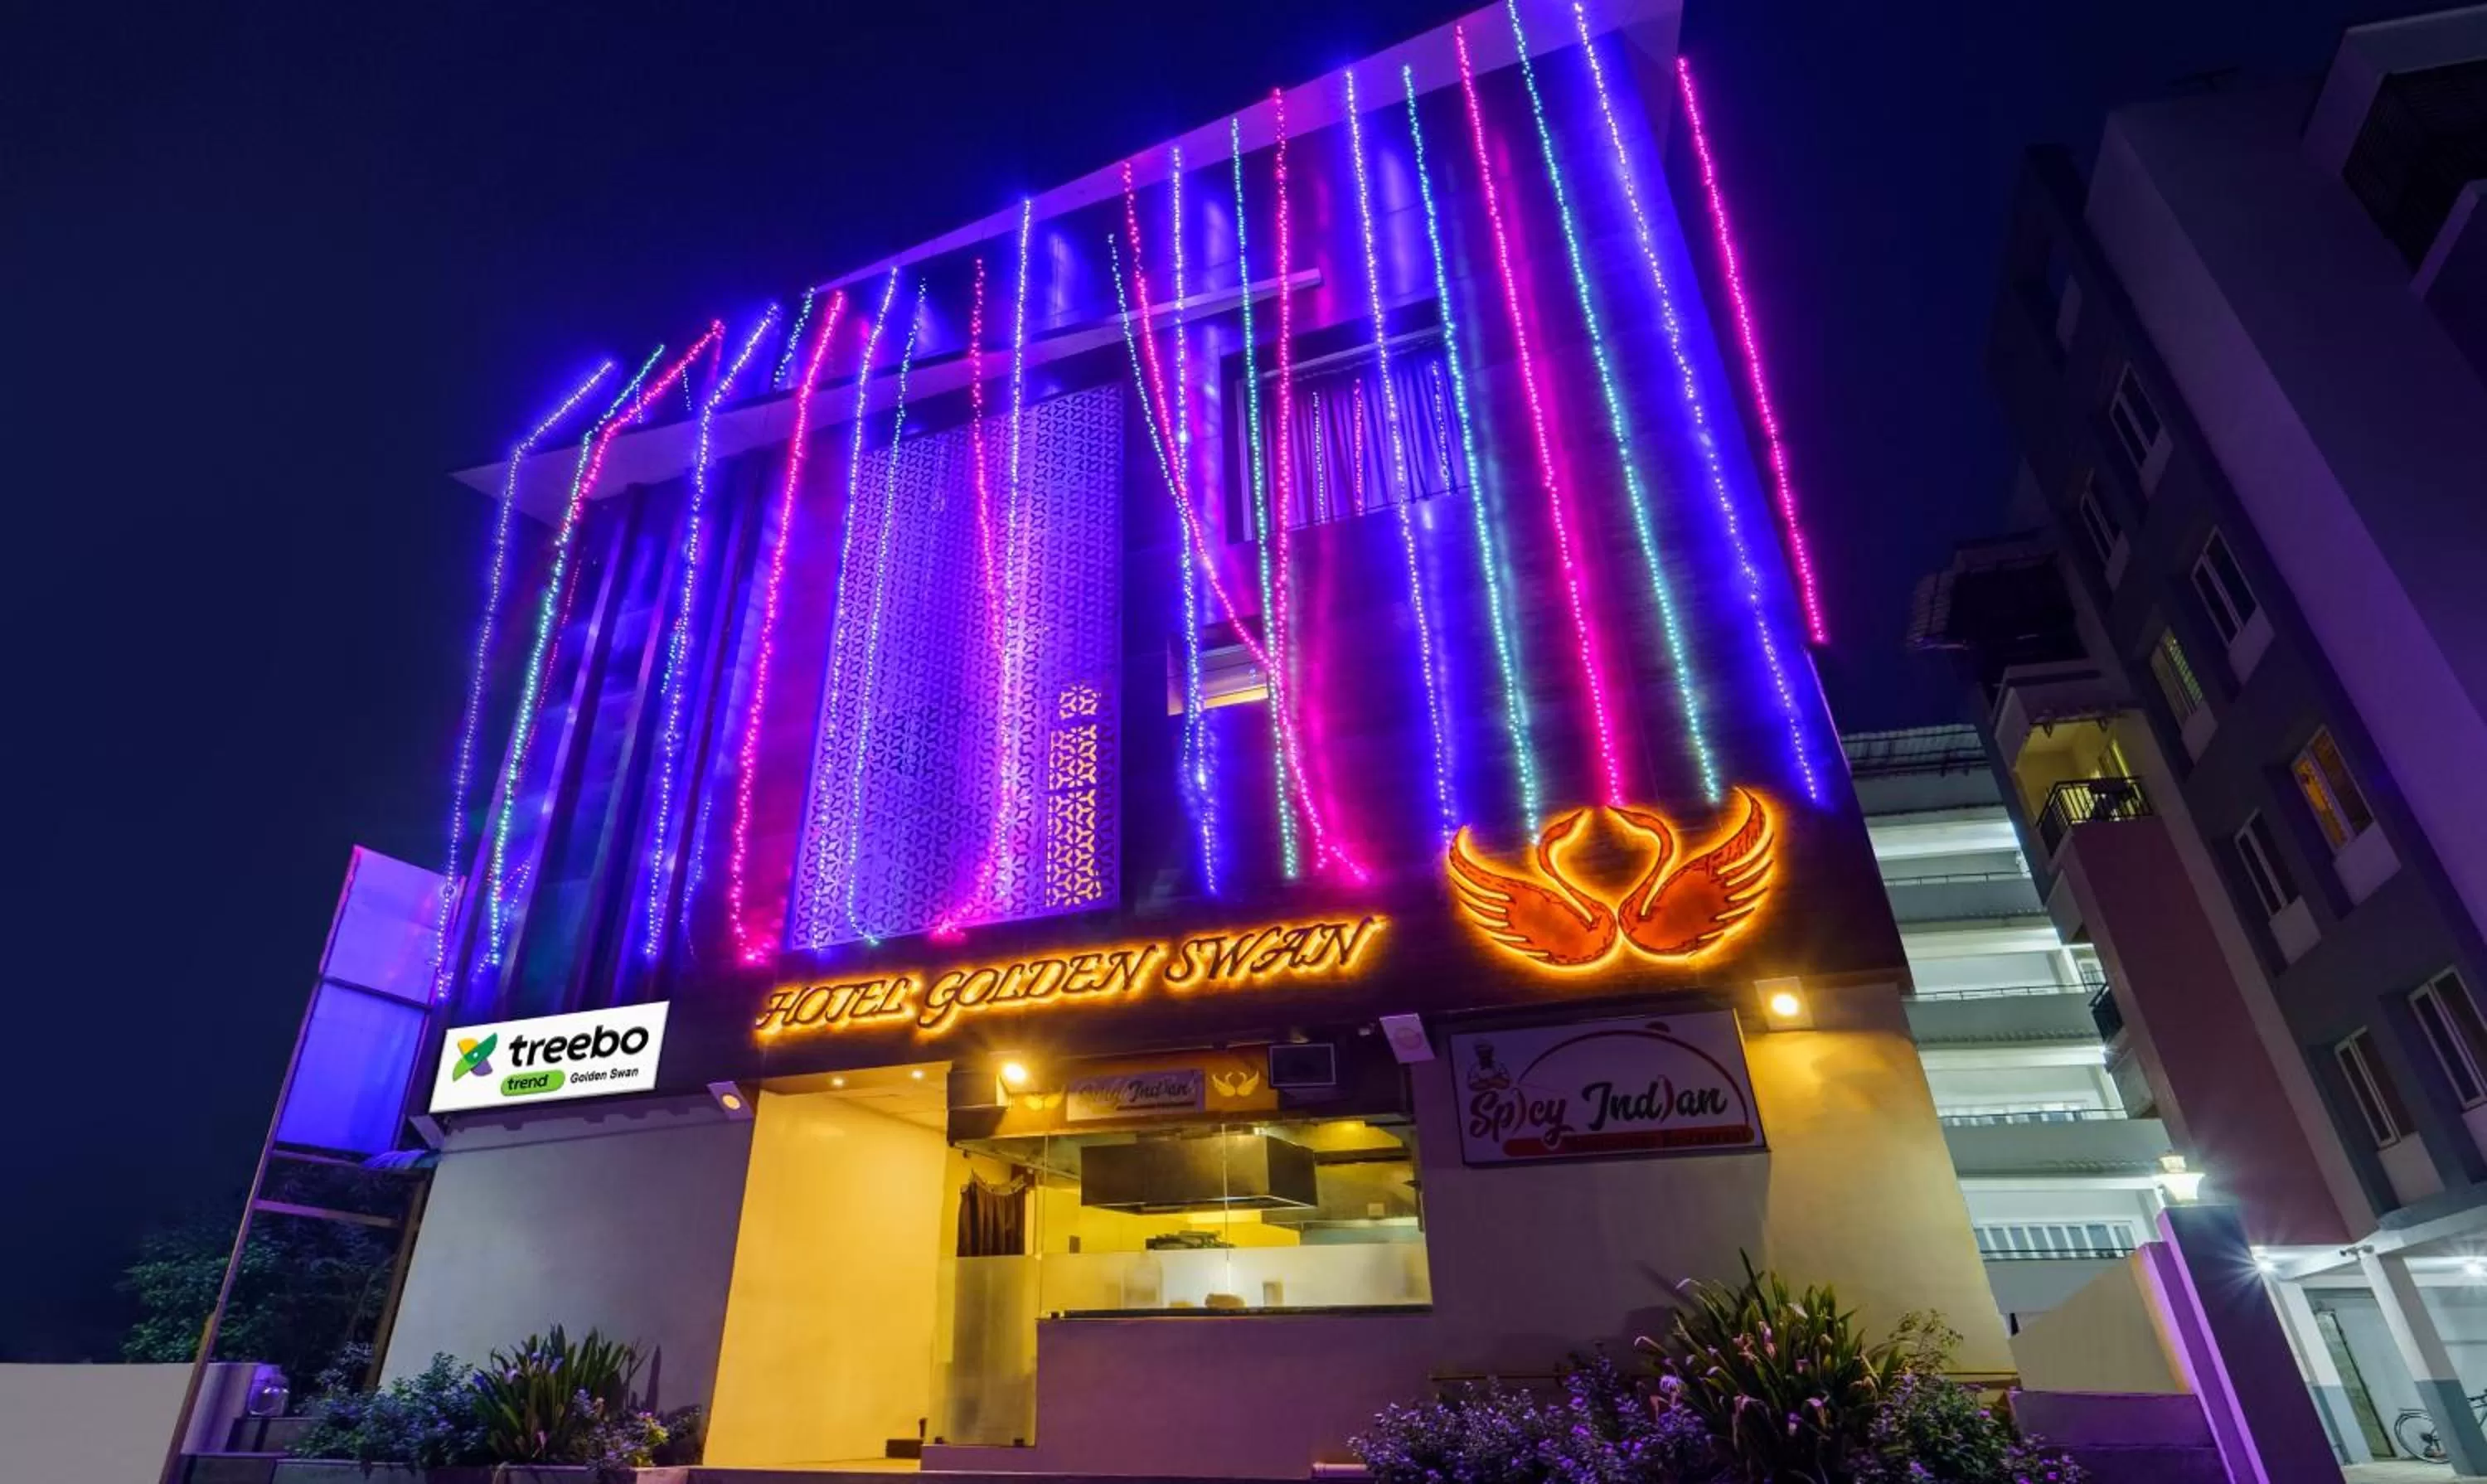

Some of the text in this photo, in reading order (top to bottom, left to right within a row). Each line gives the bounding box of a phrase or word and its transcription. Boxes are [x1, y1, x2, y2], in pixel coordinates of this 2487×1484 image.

[755, 916, 1374, 1030] HOTEL GOLDEN SWAN
[508, 1025, 649, 1067] treebo
[507, 1074, 549, 1091] trend
[570, 1066, 639, 1084] Golden Swan
